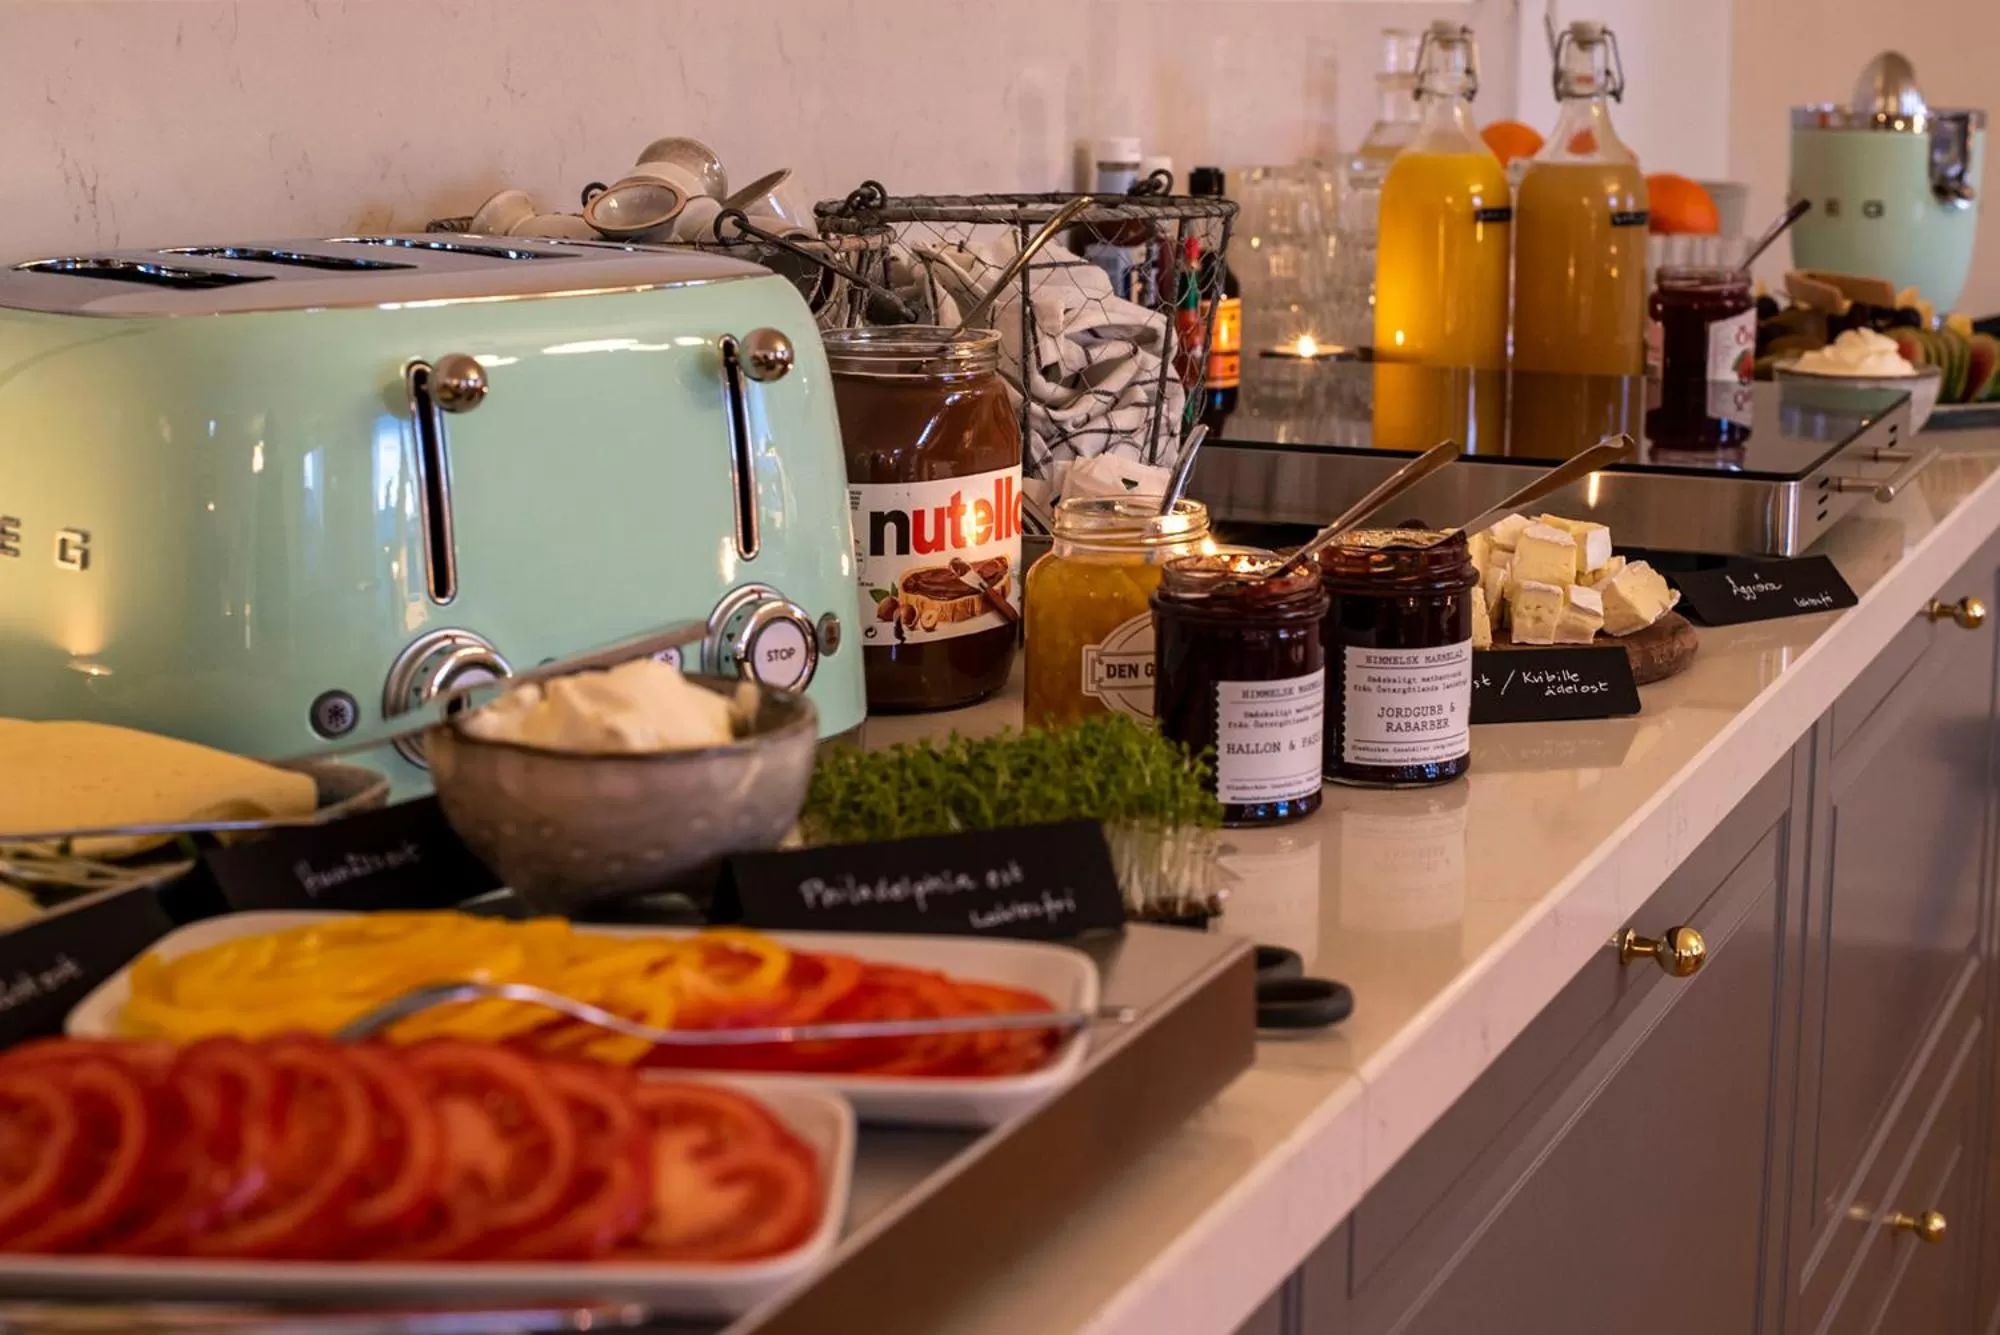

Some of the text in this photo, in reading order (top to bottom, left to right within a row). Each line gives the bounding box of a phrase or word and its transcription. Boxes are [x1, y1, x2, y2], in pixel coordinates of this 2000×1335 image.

[766, 647, 796, 662] STOP
[1106, 663, 1139, 679] DEN
[1522, 669, 1580, 684] Kvibille
[1377, 704, 1444, 718] JORDGUBB
[1385, 718, 1450, 733] RABARBER
[1226, 741, 1281, 755] HALLON
[1289, 740, 1296, 751] &
